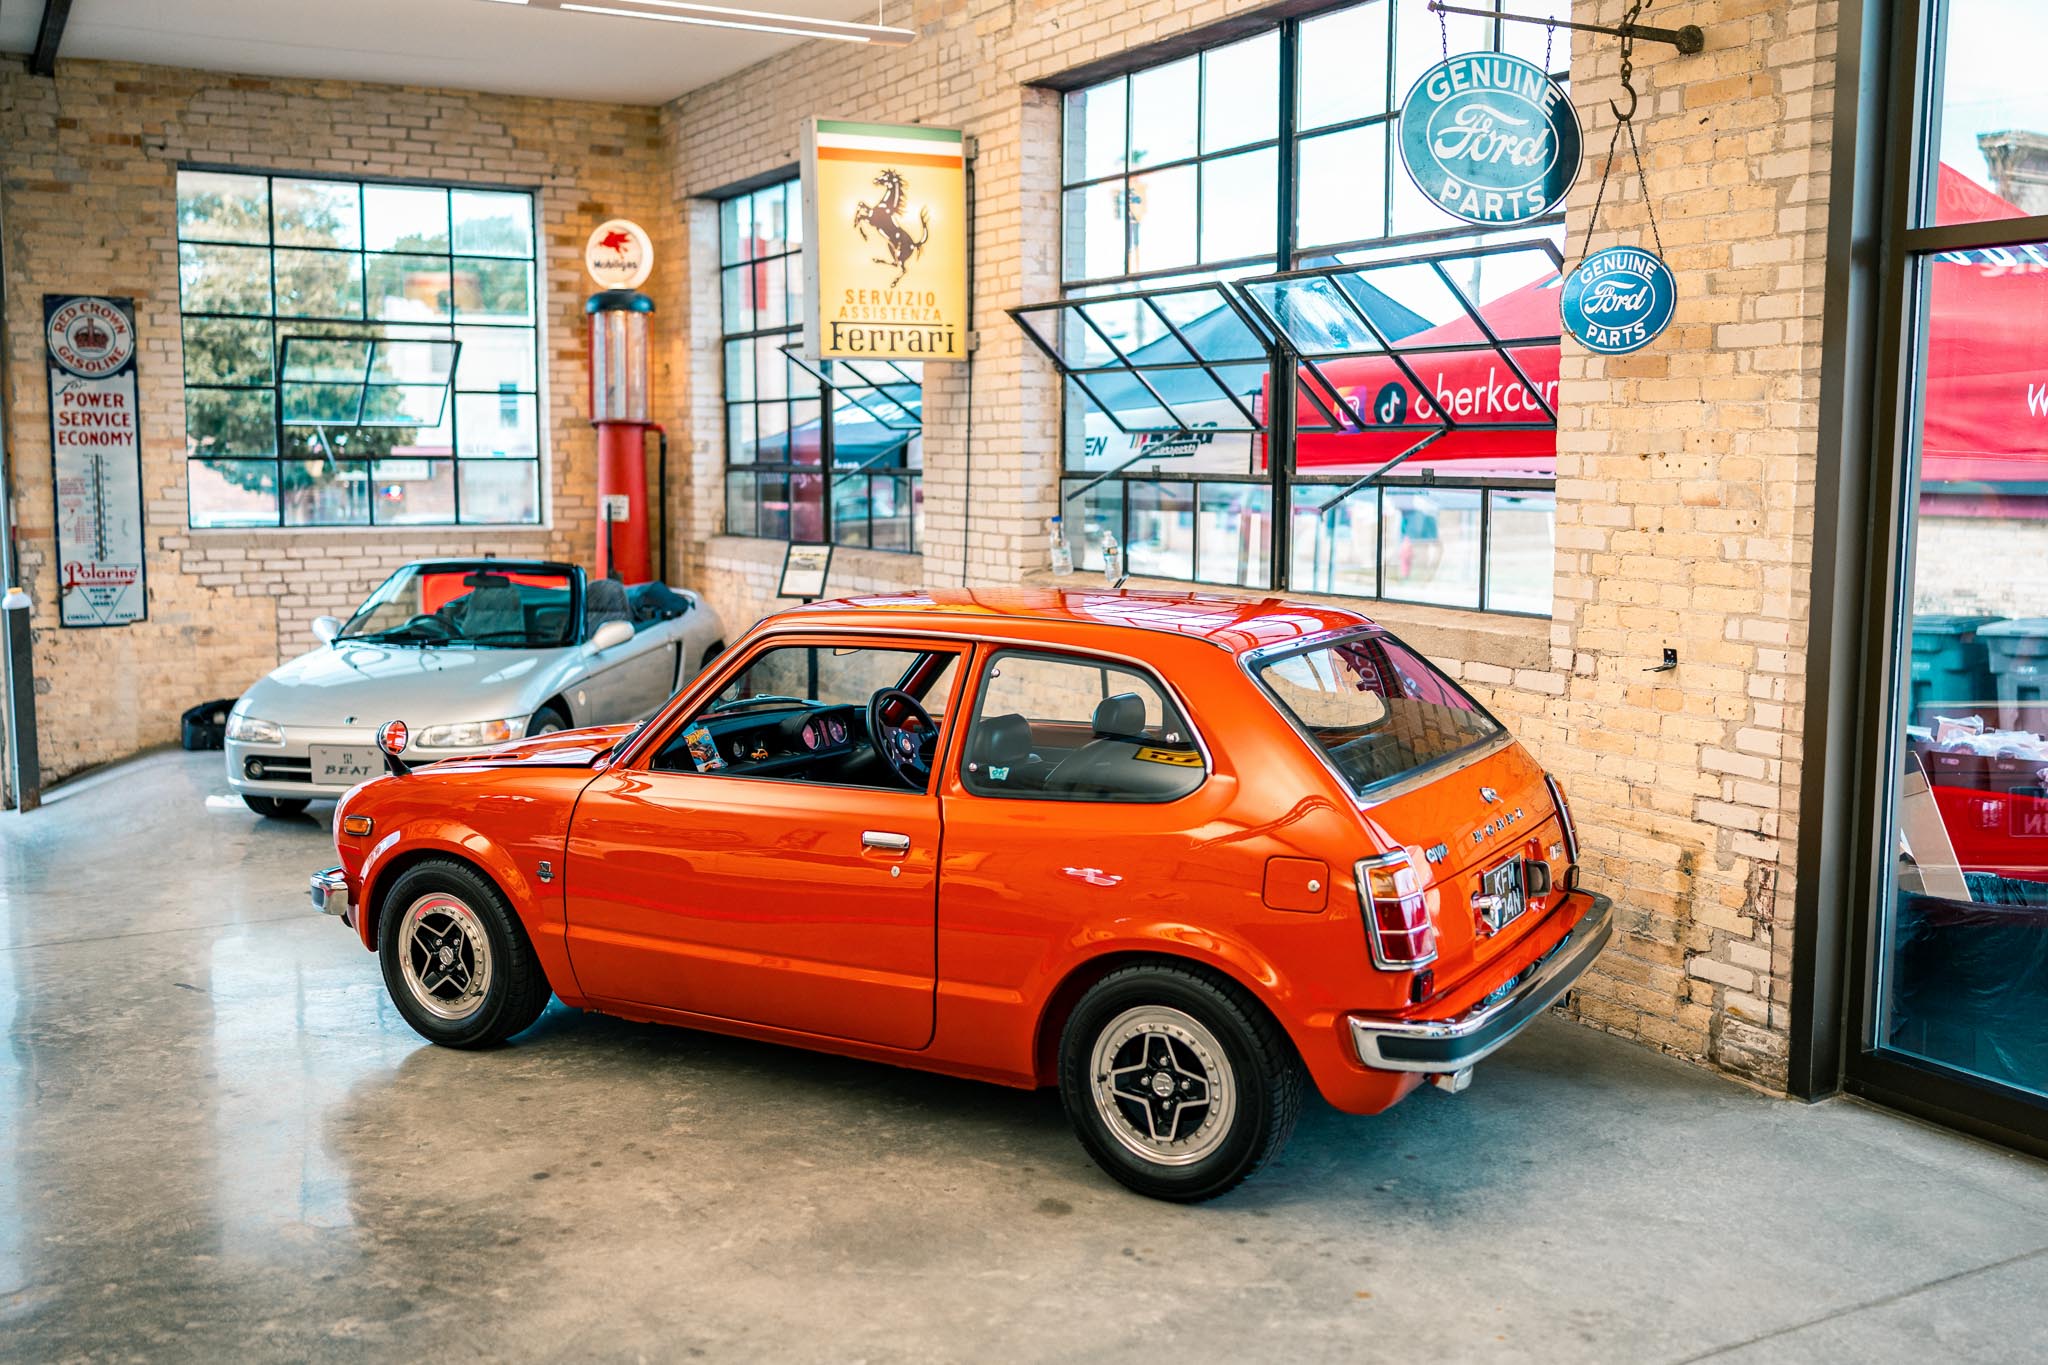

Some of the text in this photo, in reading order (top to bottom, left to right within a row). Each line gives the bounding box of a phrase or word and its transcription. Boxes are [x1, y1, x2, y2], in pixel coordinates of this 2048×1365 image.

[1427, 59, 1562, 117] GENUINE
[1434, 103, 1551, 167] Ford
[1439, 177, 1546, 220] PARTS
[1580, 253, 1657, 284] GENUINE
[845, 289, 936, 307] SERVIZIO
[1584, 280, 1648, 314] Ford
[54, 302, 126, 335] RED CROWN
[839, 306, 942, 321] ASSISTENZA
[830, 321, 954, 353] Ferrari
[1586, 322, 1646, 346] PARTS
[58, 346, 125, 373] GASOLINE
[63, 392, 124, 408] POWER
[59, 411, 132, 427] SERVICE
[58, 430, 133, 446] ECONOMY
[64, 561, 139, 587] Polarine
[325, 765, 372, 775] BEAT
